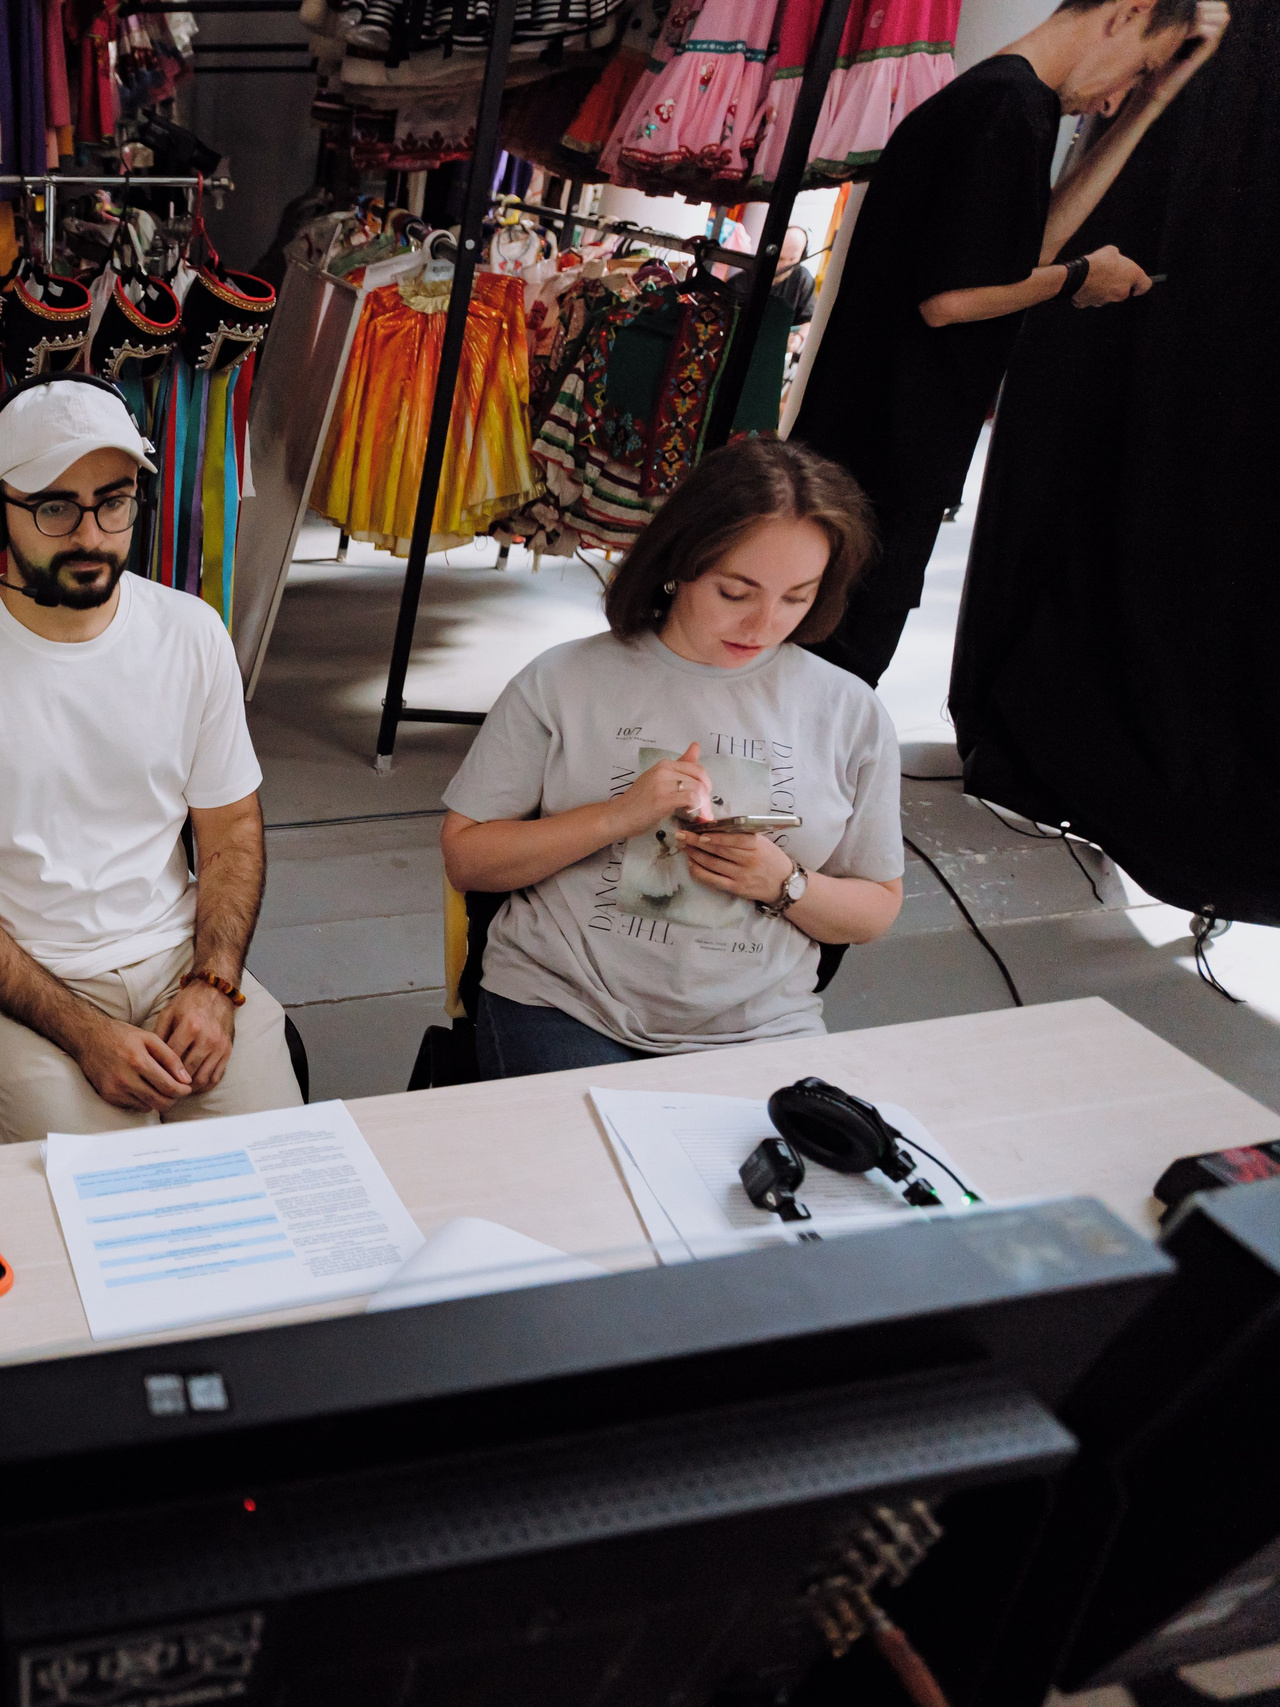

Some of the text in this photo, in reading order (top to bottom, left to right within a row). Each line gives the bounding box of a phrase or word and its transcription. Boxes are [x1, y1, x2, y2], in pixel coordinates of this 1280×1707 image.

[616, 727, 643, 737] 10/7
[710, 732, 766, 762] THE
[618, 914, 674, 945] THE
[731, 942, 764, 954] 19.30
